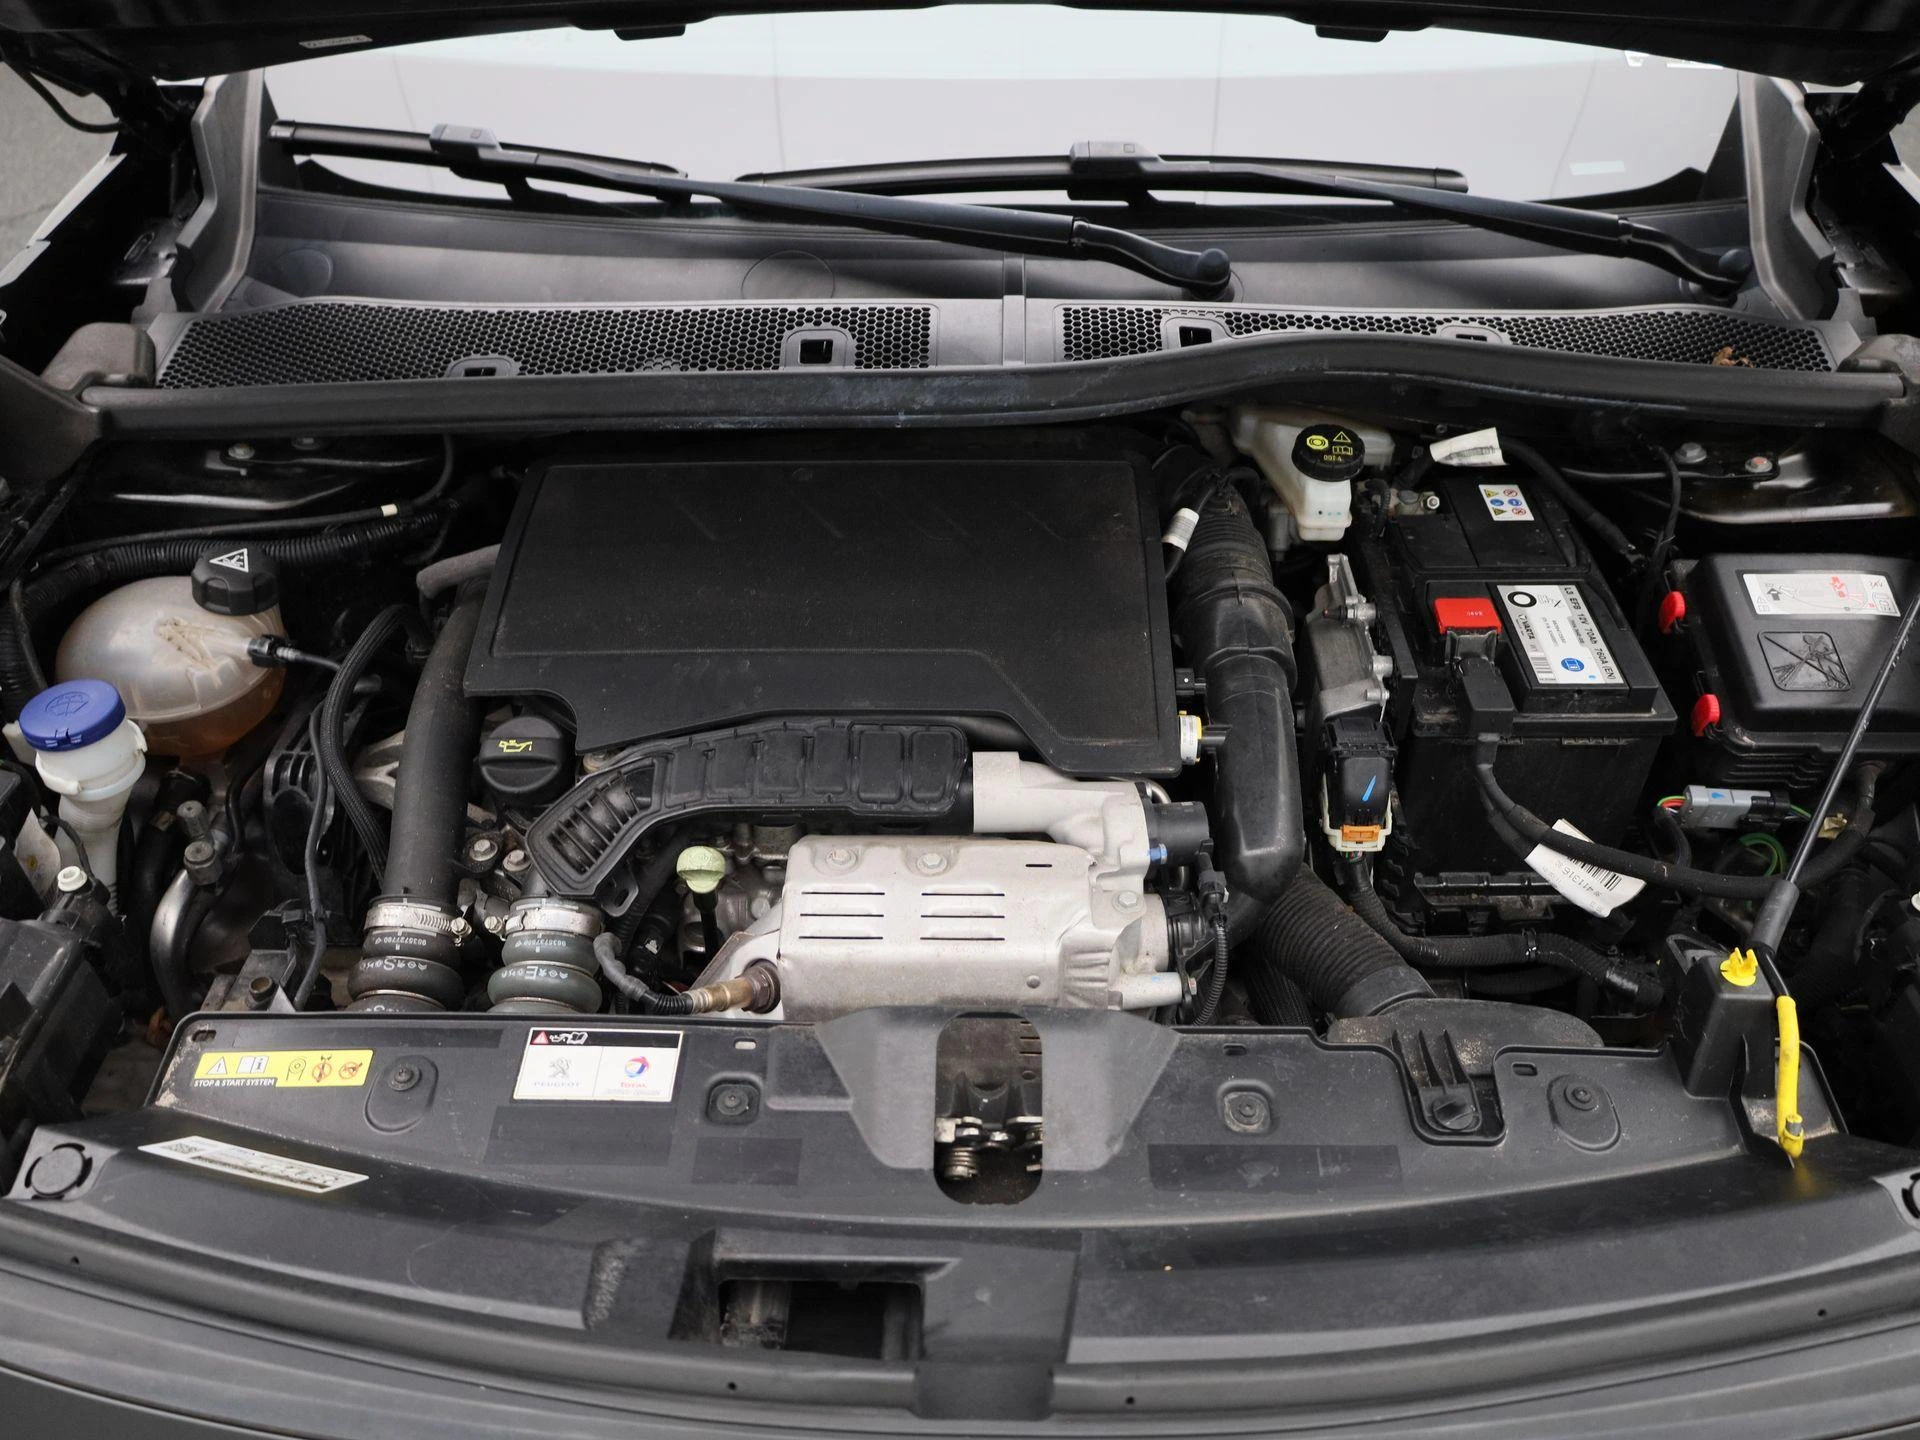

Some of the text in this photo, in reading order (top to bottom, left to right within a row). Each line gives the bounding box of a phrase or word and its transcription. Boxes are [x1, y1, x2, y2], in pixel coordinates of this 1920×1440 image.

[1522, 620, 1535, 640] VARTA
[1577, 613, 1589, 625] 12V
[1584, 628, 1598, 645] 70Ah
[1594, 648, 1609, 665] 760A
[1602, 665, 1616, 680] (EN)
[194, 1079, 214, 1087] STOP
[221, 1079, 245, 1087] START
[246, 1078, 275, 1087] SYSTEM
